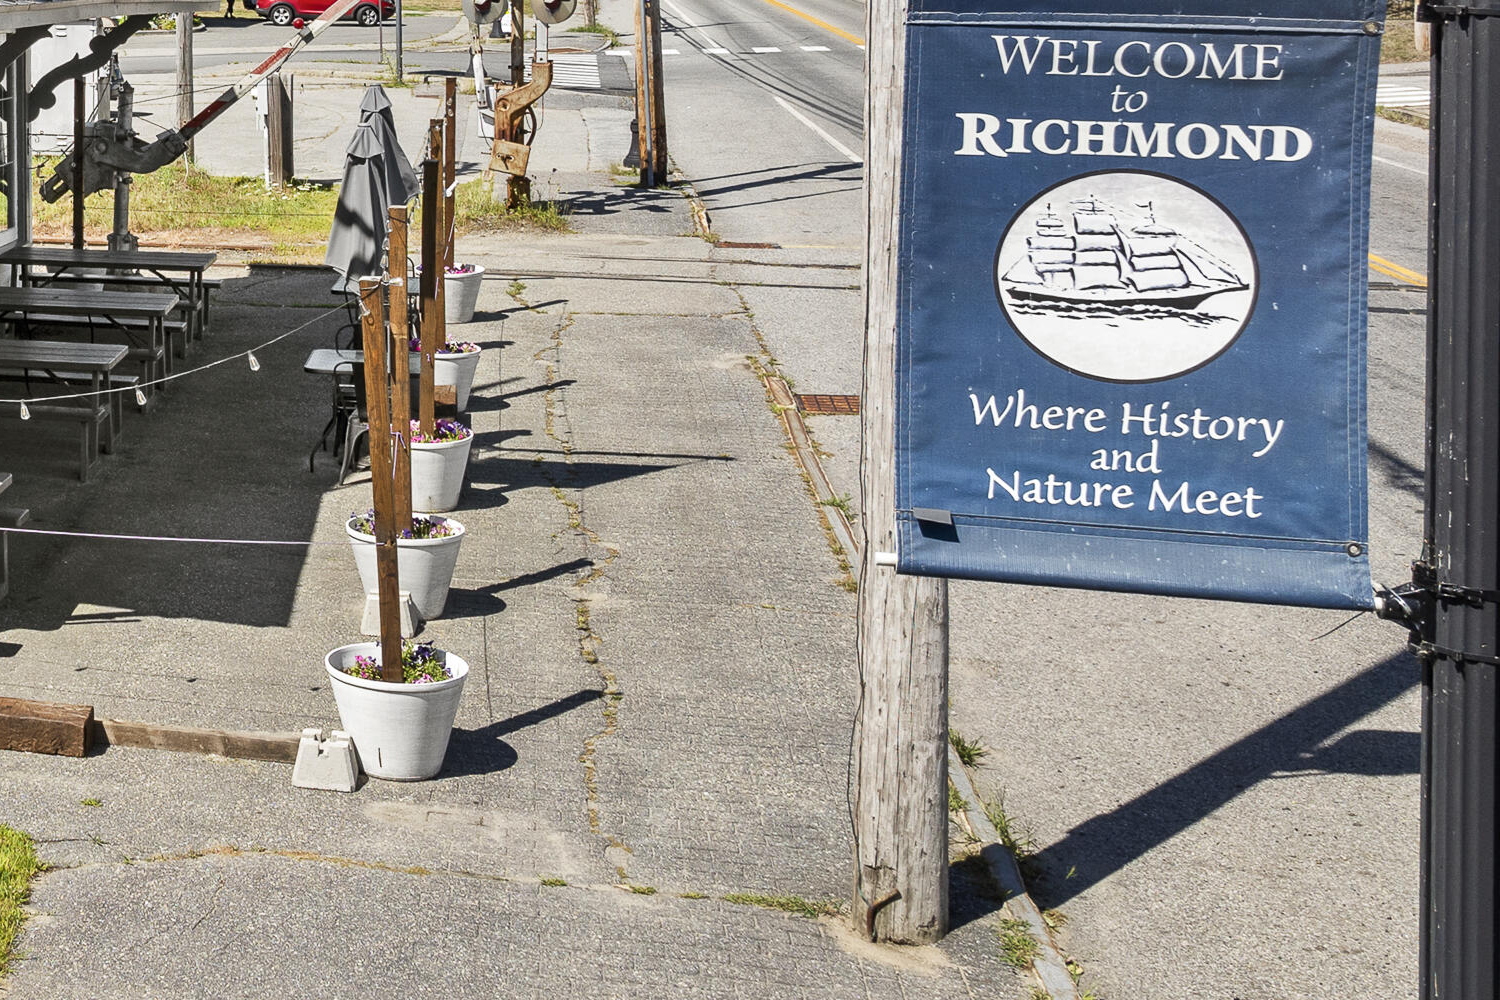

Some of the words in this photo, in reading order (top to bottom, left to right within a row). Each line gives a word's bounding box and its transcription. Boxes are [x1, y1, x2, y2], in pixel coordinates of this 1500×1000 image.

[991, 34, 1285, 81] WELCOME
[1111, 84, 1148, 114] to
[954, 112, 1313, 163] RICHMOND
[968, 388, 1107, 434] Where
[1121, 401, 1285, 458] History
[1090, 438, 1163, 475] and
[986, 467, 1135, 510] Nature
[1148, 478, 1264, 519] Meet
